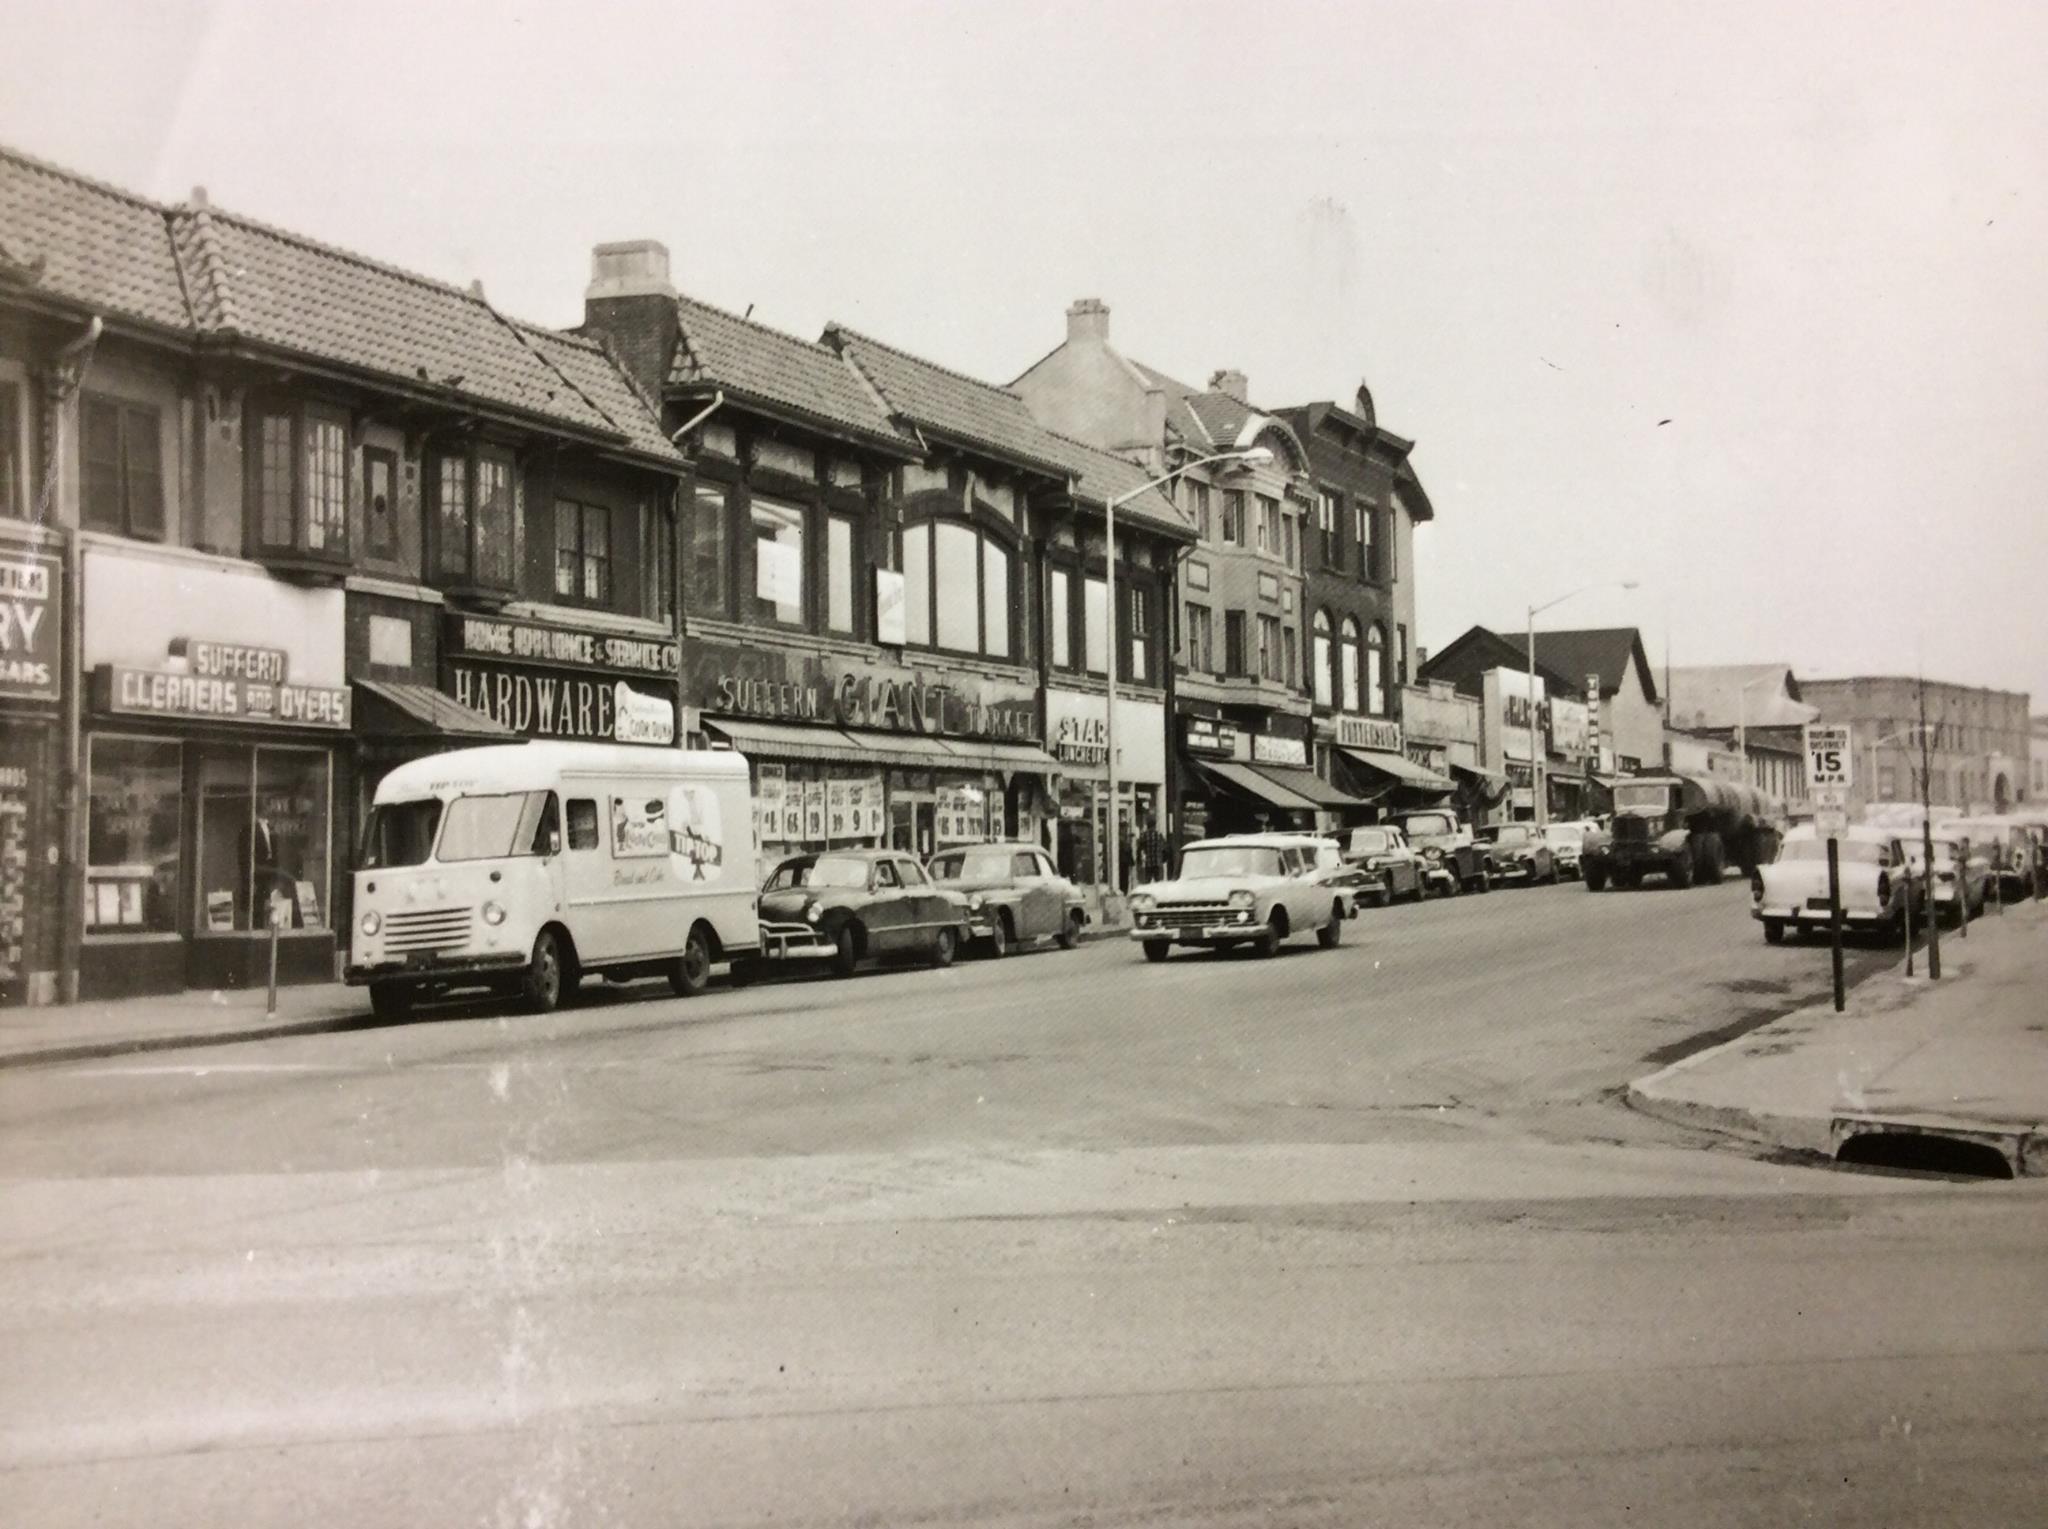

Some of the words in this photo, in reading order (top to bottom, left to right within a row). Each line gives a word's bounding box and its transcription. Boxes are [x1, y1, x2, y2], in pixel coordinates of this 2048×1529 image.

[198, 644, 282, 681] SUFFERN
[121, 672, 238, 714] CLEANERS
[247, 688, 273, 711] AND
[280, 687, 344, 722] DYERS
[455, 669, 614, 737] HARDWARE
[720, 677, 817, 718] SUFFERN
[834, 672, 949, 735] GIANT
[1059, 717, 1104, 744] STAR
[1810, 741, 1846, 750] DISTRICT
[1816, 751, 1841, 772] 15
